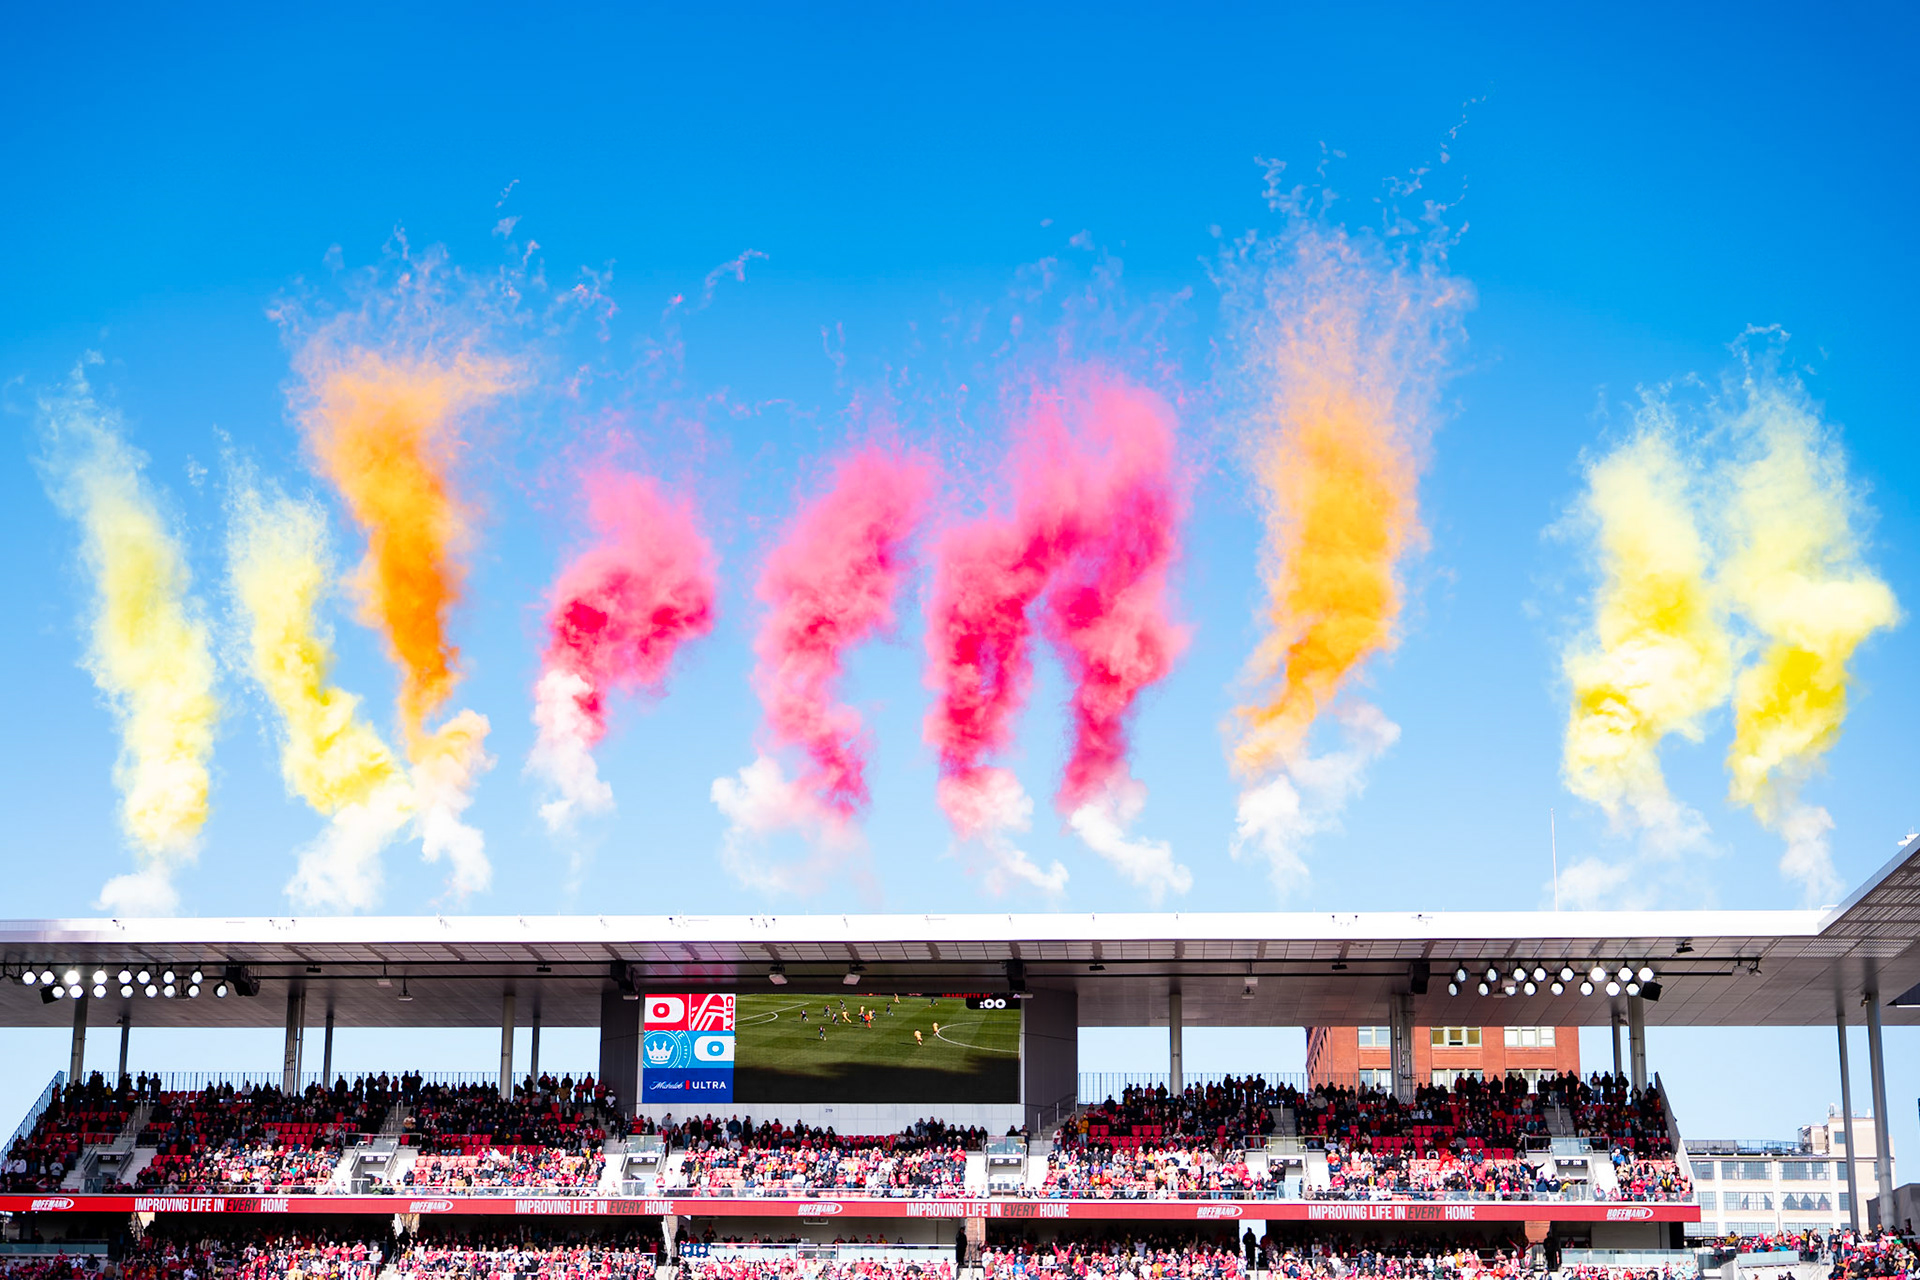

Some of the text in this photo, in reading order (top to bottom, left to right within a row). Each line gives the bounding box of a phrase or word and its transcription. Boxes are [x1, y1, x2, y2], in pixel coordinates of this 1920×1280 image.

[725, 996, 734, 1031] CITY
[692, 1081, 727, 1090] ULTRA
[31, 1199, 69, 1208] HOFFMANN
[134, 1198, 289, 1212] IMPROVING LIFE IN EVERY HOME
[410, 1201, 447, 1210] HOFFMANN
[515, 1200, 674, 1214] IMPROVING LIFE IN EVERY HOME
[798, 1204, 837, 1212] HOFFMANN
[906, 1203, 1069, 1217] IMPROVING LIFE IN EVERY HOME
[1197, 1207, 1236, 1215] HOFFMANN
[1308, 1205, 1475, 1220] IMPROVING LIFE IN EVERY HOME
[1606, 1209, 1647, 1217] HOFFMANN
